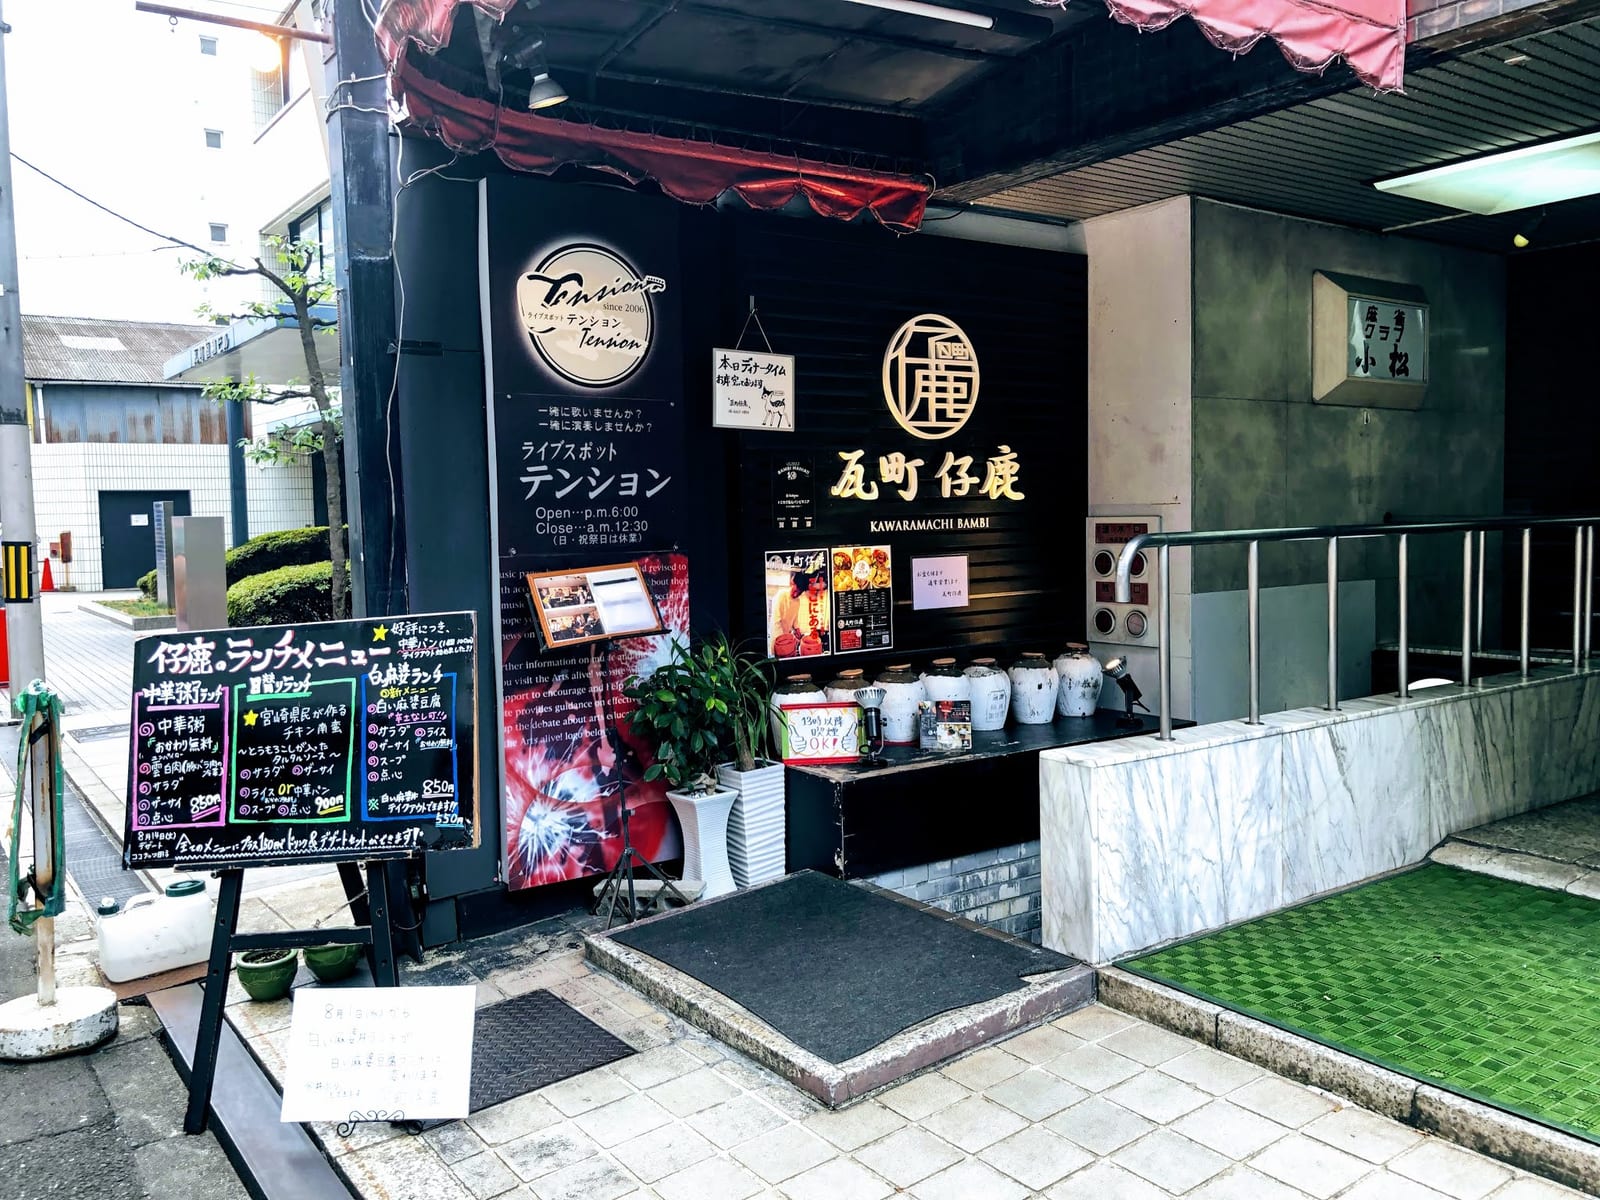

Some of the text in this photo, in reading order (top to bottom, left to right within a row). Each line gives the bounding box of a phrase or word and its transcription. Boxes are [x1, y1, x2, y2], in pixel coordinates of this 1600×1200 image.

[603, 303, 645, 314] since 2006
[1366, 305, 1406, 327] 麻雀
[567, 314, 622, 329] テンション
[579, 328, 643, 350] Tension
[718, 354, 787, 377] 本日ディナータイム
[1355, 340, 1409, 377] 小松
[522, 440, 618, 461] ライブスポット
[519, 465, 672, 501] テンション
[870, 517, 989, 532] KAWARAMACHI BAMBI
[649, 565, 676, 573] revised
[526, 658, 577, 669] information
[514, 676, 533, 686] visit
[536, 674, 550, 683] the
[552, 671, 570, 681] Arts
[142, 680, 223, 705] 中華粥ランチ
[532, 691, 541, 699] to
[543, 685, 587, 700] encourage
[588, 683, 604, 693] and
[377, 693, 441, 713] 白い麻婆豆腐
[515, 705, 553, 719] provides
[555, 700, 593, 713] guidance
[595, 698, 606, 706] on
[260, 704, 347, 727] 宮崎県民が作る
[516, 720, 529, 730] the
[532, 718, 561, 729] debate
[563, 715, 587, 726] about
[589, 712, 604, 722] arts
[158, 715, 205, 736] 中華粥
[283, 719, 343, 740] チキン南蛮
[378, 725, 446, 738] サラダ ライス
[379, 739, 410, 752] ザーサイ
[520, 736, 538, 746] Arts
[565, 730, 583, 741] logo
[810, 737, 838, 750] OK!
[380, 754, 406, 766] スープ
[252, 762, 335, 778] サラダ ザーサイ
[381, 769, 402, 782] 点心
[153, 777, 184, 792] サラダ
[252, 783, 330, 799] ライス or 中華パン
[422, 779, 455, 795] 850円
[151, 796, 181, 809] ザーサイ
[190, 793, 222, 815] 850円
[252, 803, 311, 817] スープ 点心
[315, 794, 344, 815] 900円
[151, 811, 173, 826] 点心
[436, 812, 464, 825] 550円
[139, 841, 163, 850] デザート
